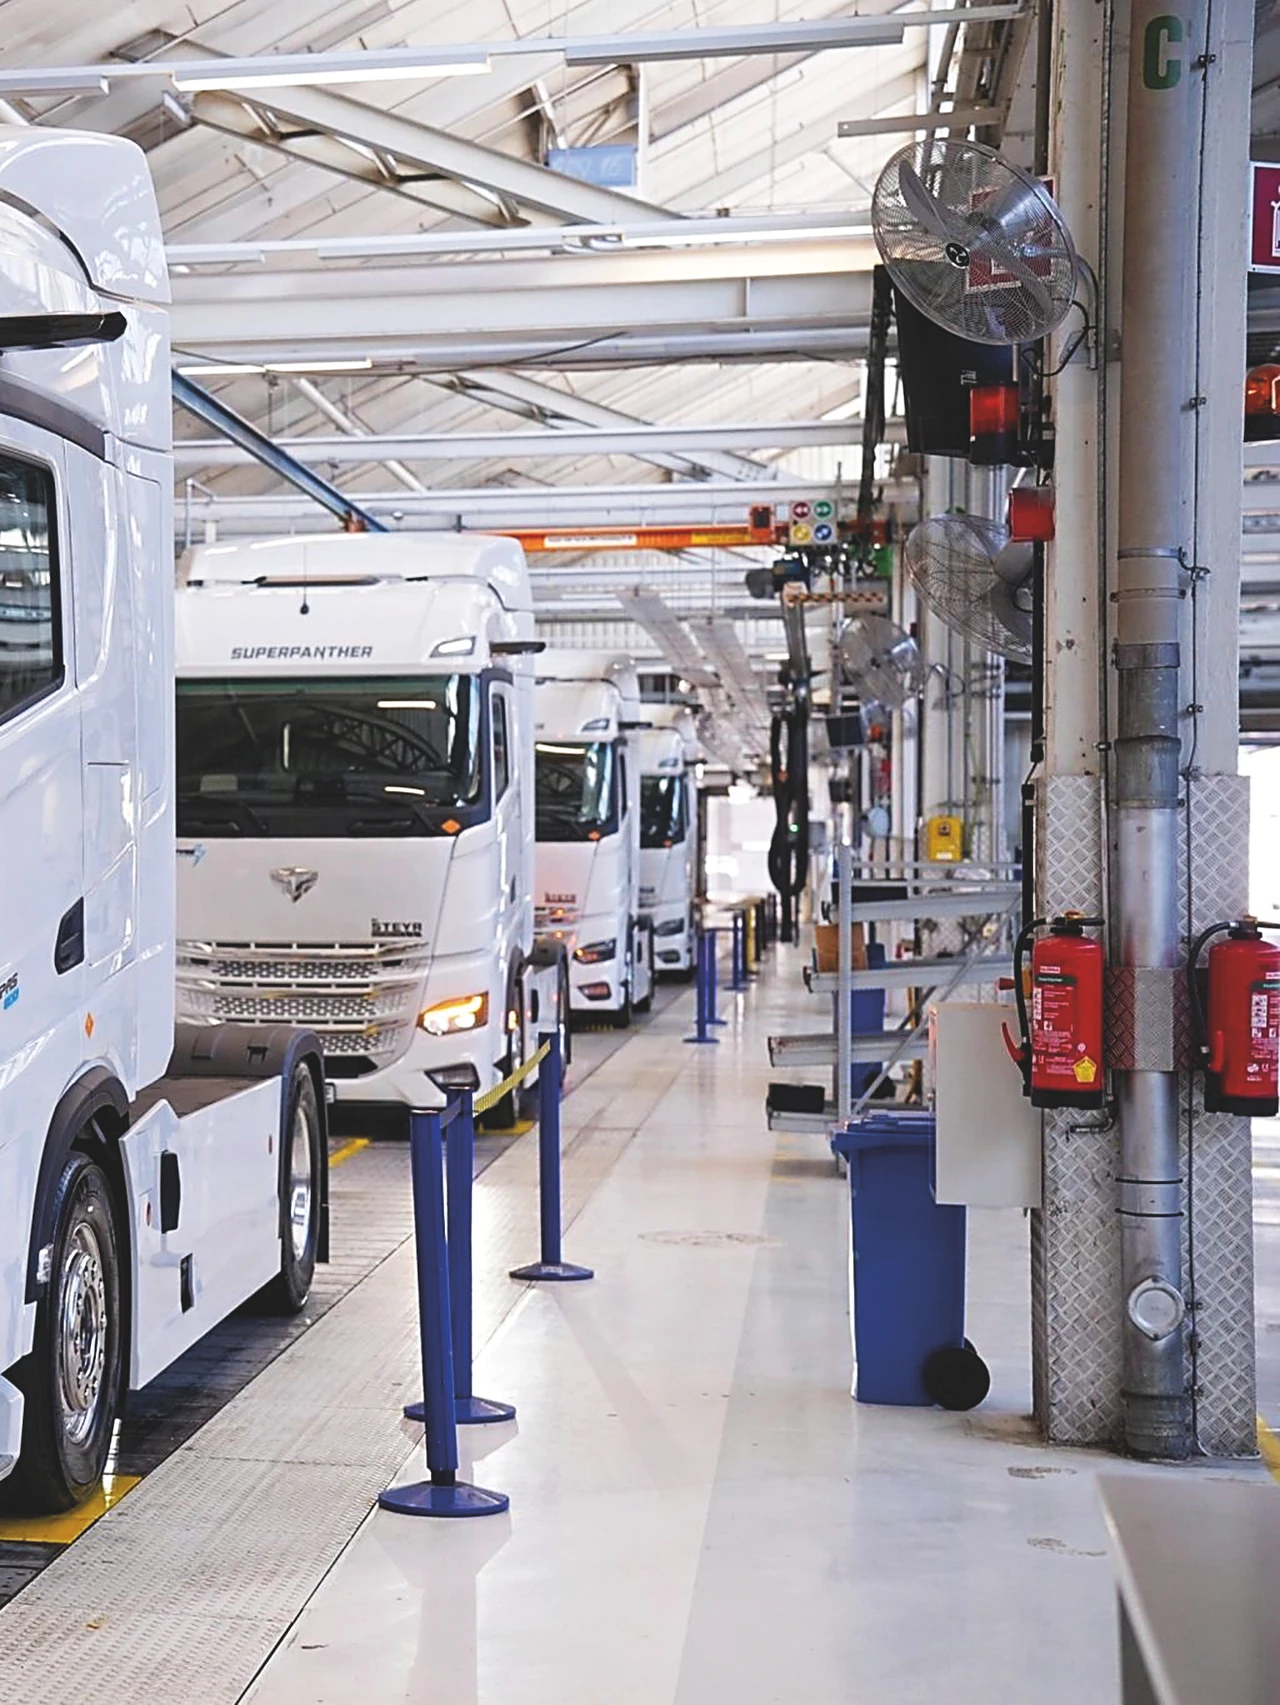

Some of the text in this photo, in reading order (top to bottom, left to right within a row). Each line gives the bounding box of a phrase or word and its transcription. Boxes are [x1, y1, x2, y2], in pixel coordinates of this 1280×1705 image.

[1144, 15, 1182, 90] C
[231, 645, 373, 660] SUPERPANTHER
[371, 921, 422, 932] STEYR
